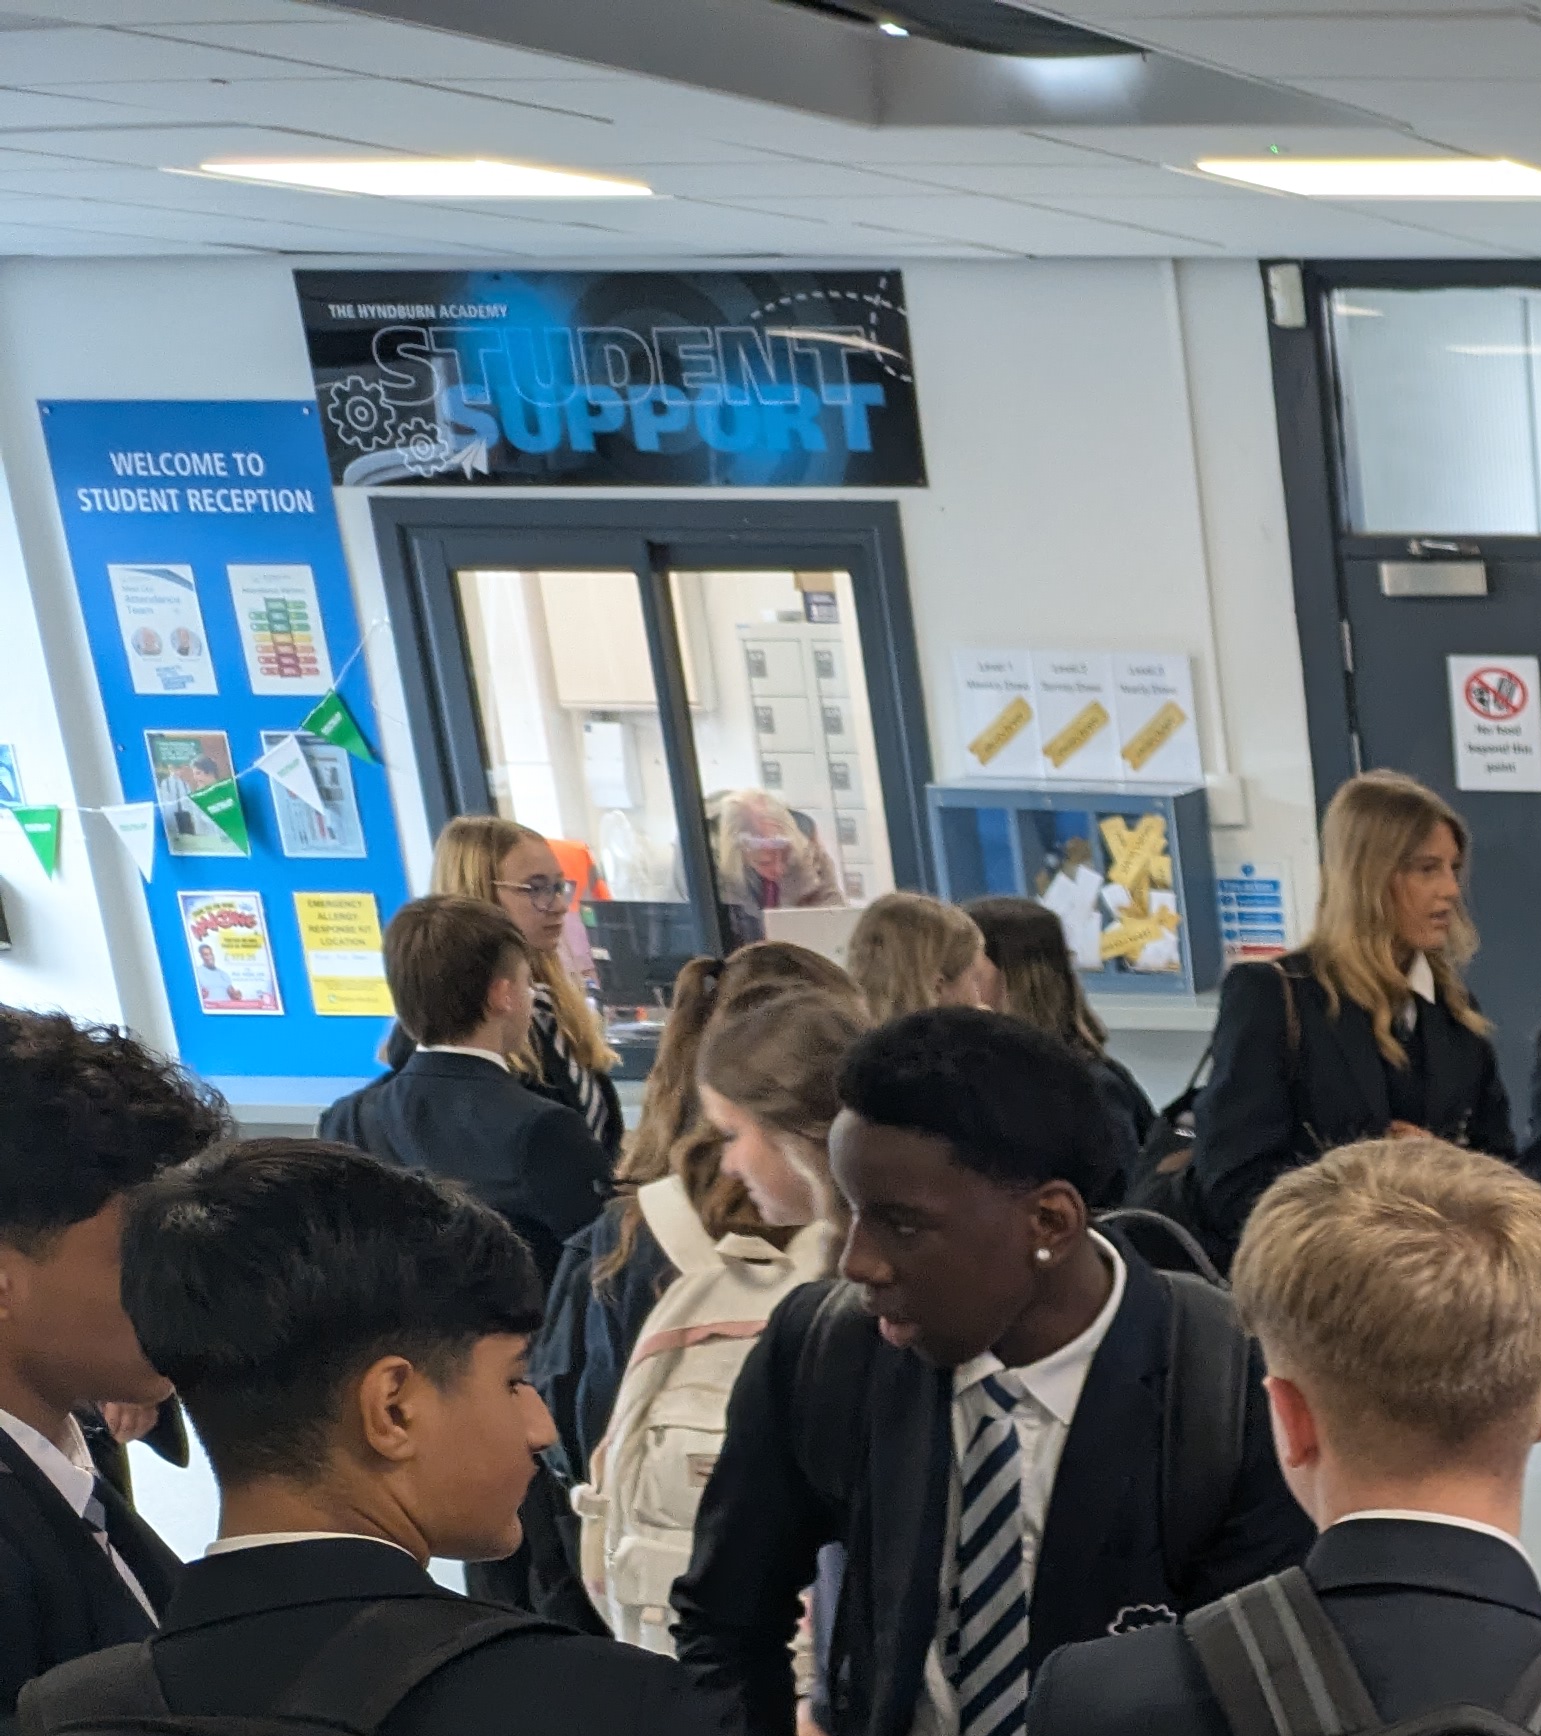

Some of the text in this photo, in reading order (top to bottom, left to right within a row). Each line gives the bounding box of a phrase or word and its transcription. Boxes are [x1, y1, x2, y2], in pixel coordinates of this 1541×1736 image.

[328, 304, 508, 320] THE HYNDBURN ACADEMY
[372, 326, 868, 405] STUDENT
[445, 383, 886, 453] SUPPORT
[110, 452, 265, 477] WELCOME TO
[78, 489, 315, 513] STUDENT RECEPTION
